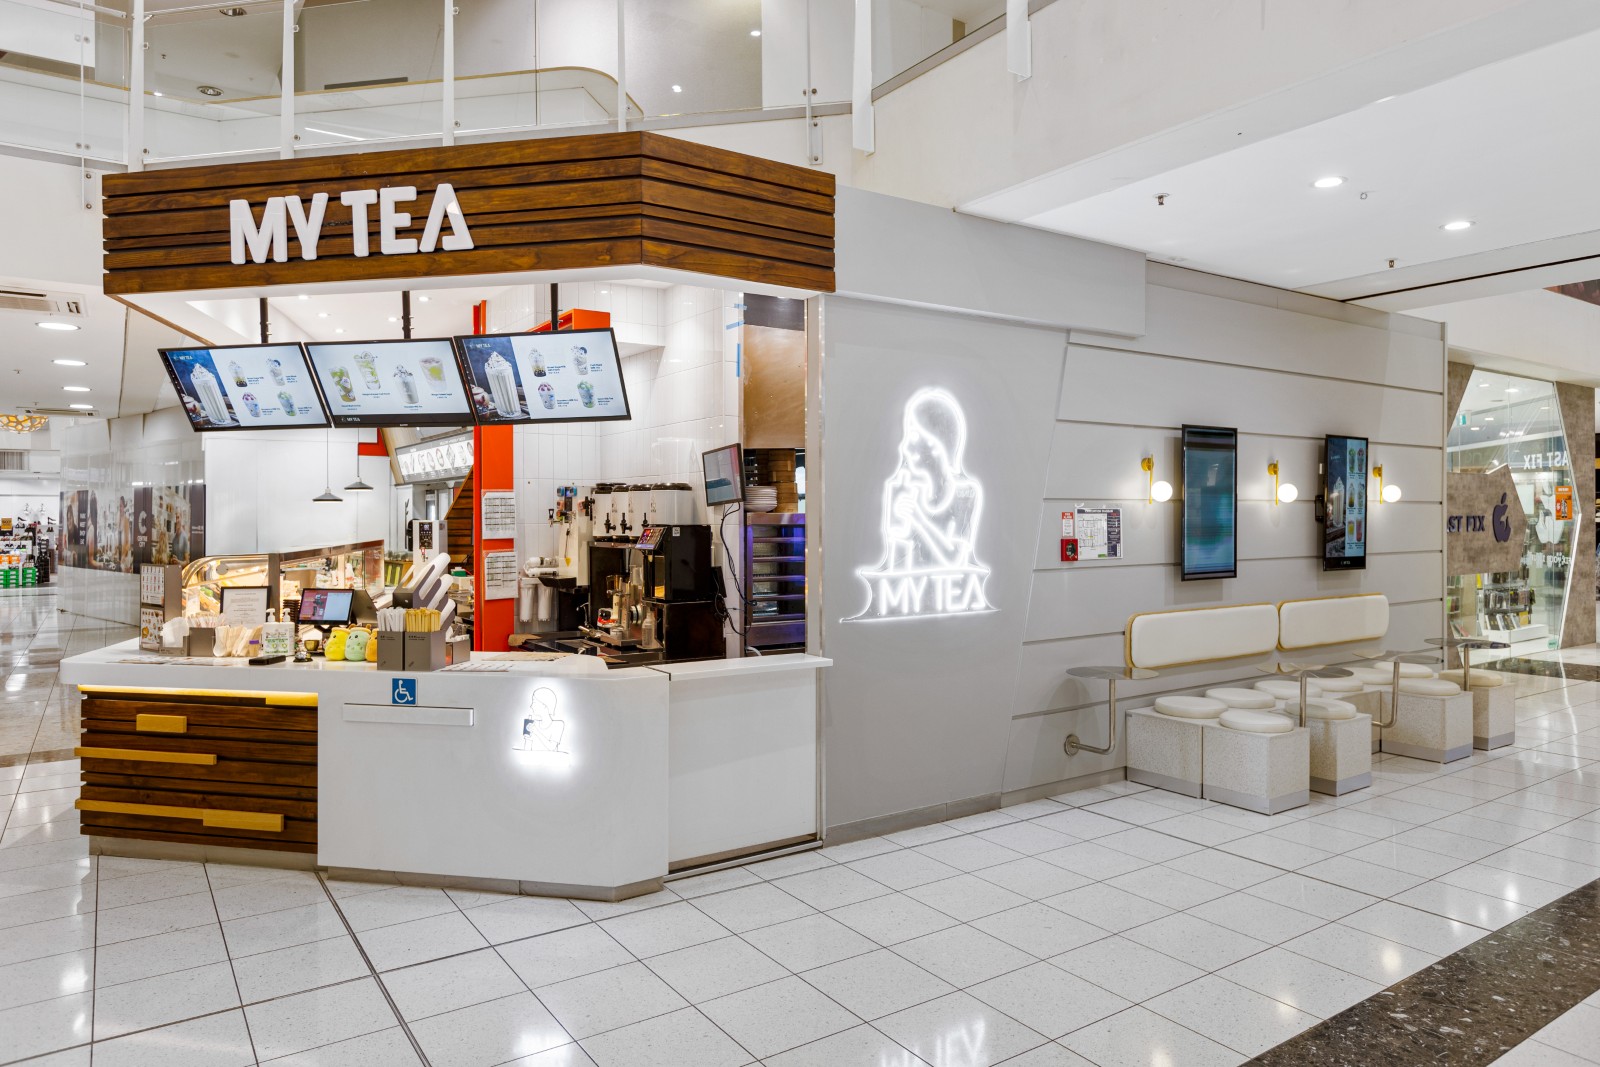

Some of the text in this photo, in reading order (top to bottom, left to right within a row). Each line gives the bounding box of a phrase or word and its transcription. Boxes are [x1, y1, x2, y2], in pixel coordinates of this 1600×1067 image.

[229, 183, 474, 265] MY TEA
[1466, 515, 1485, 532] FIX
[877, 573, 986, 616] MY TEA
